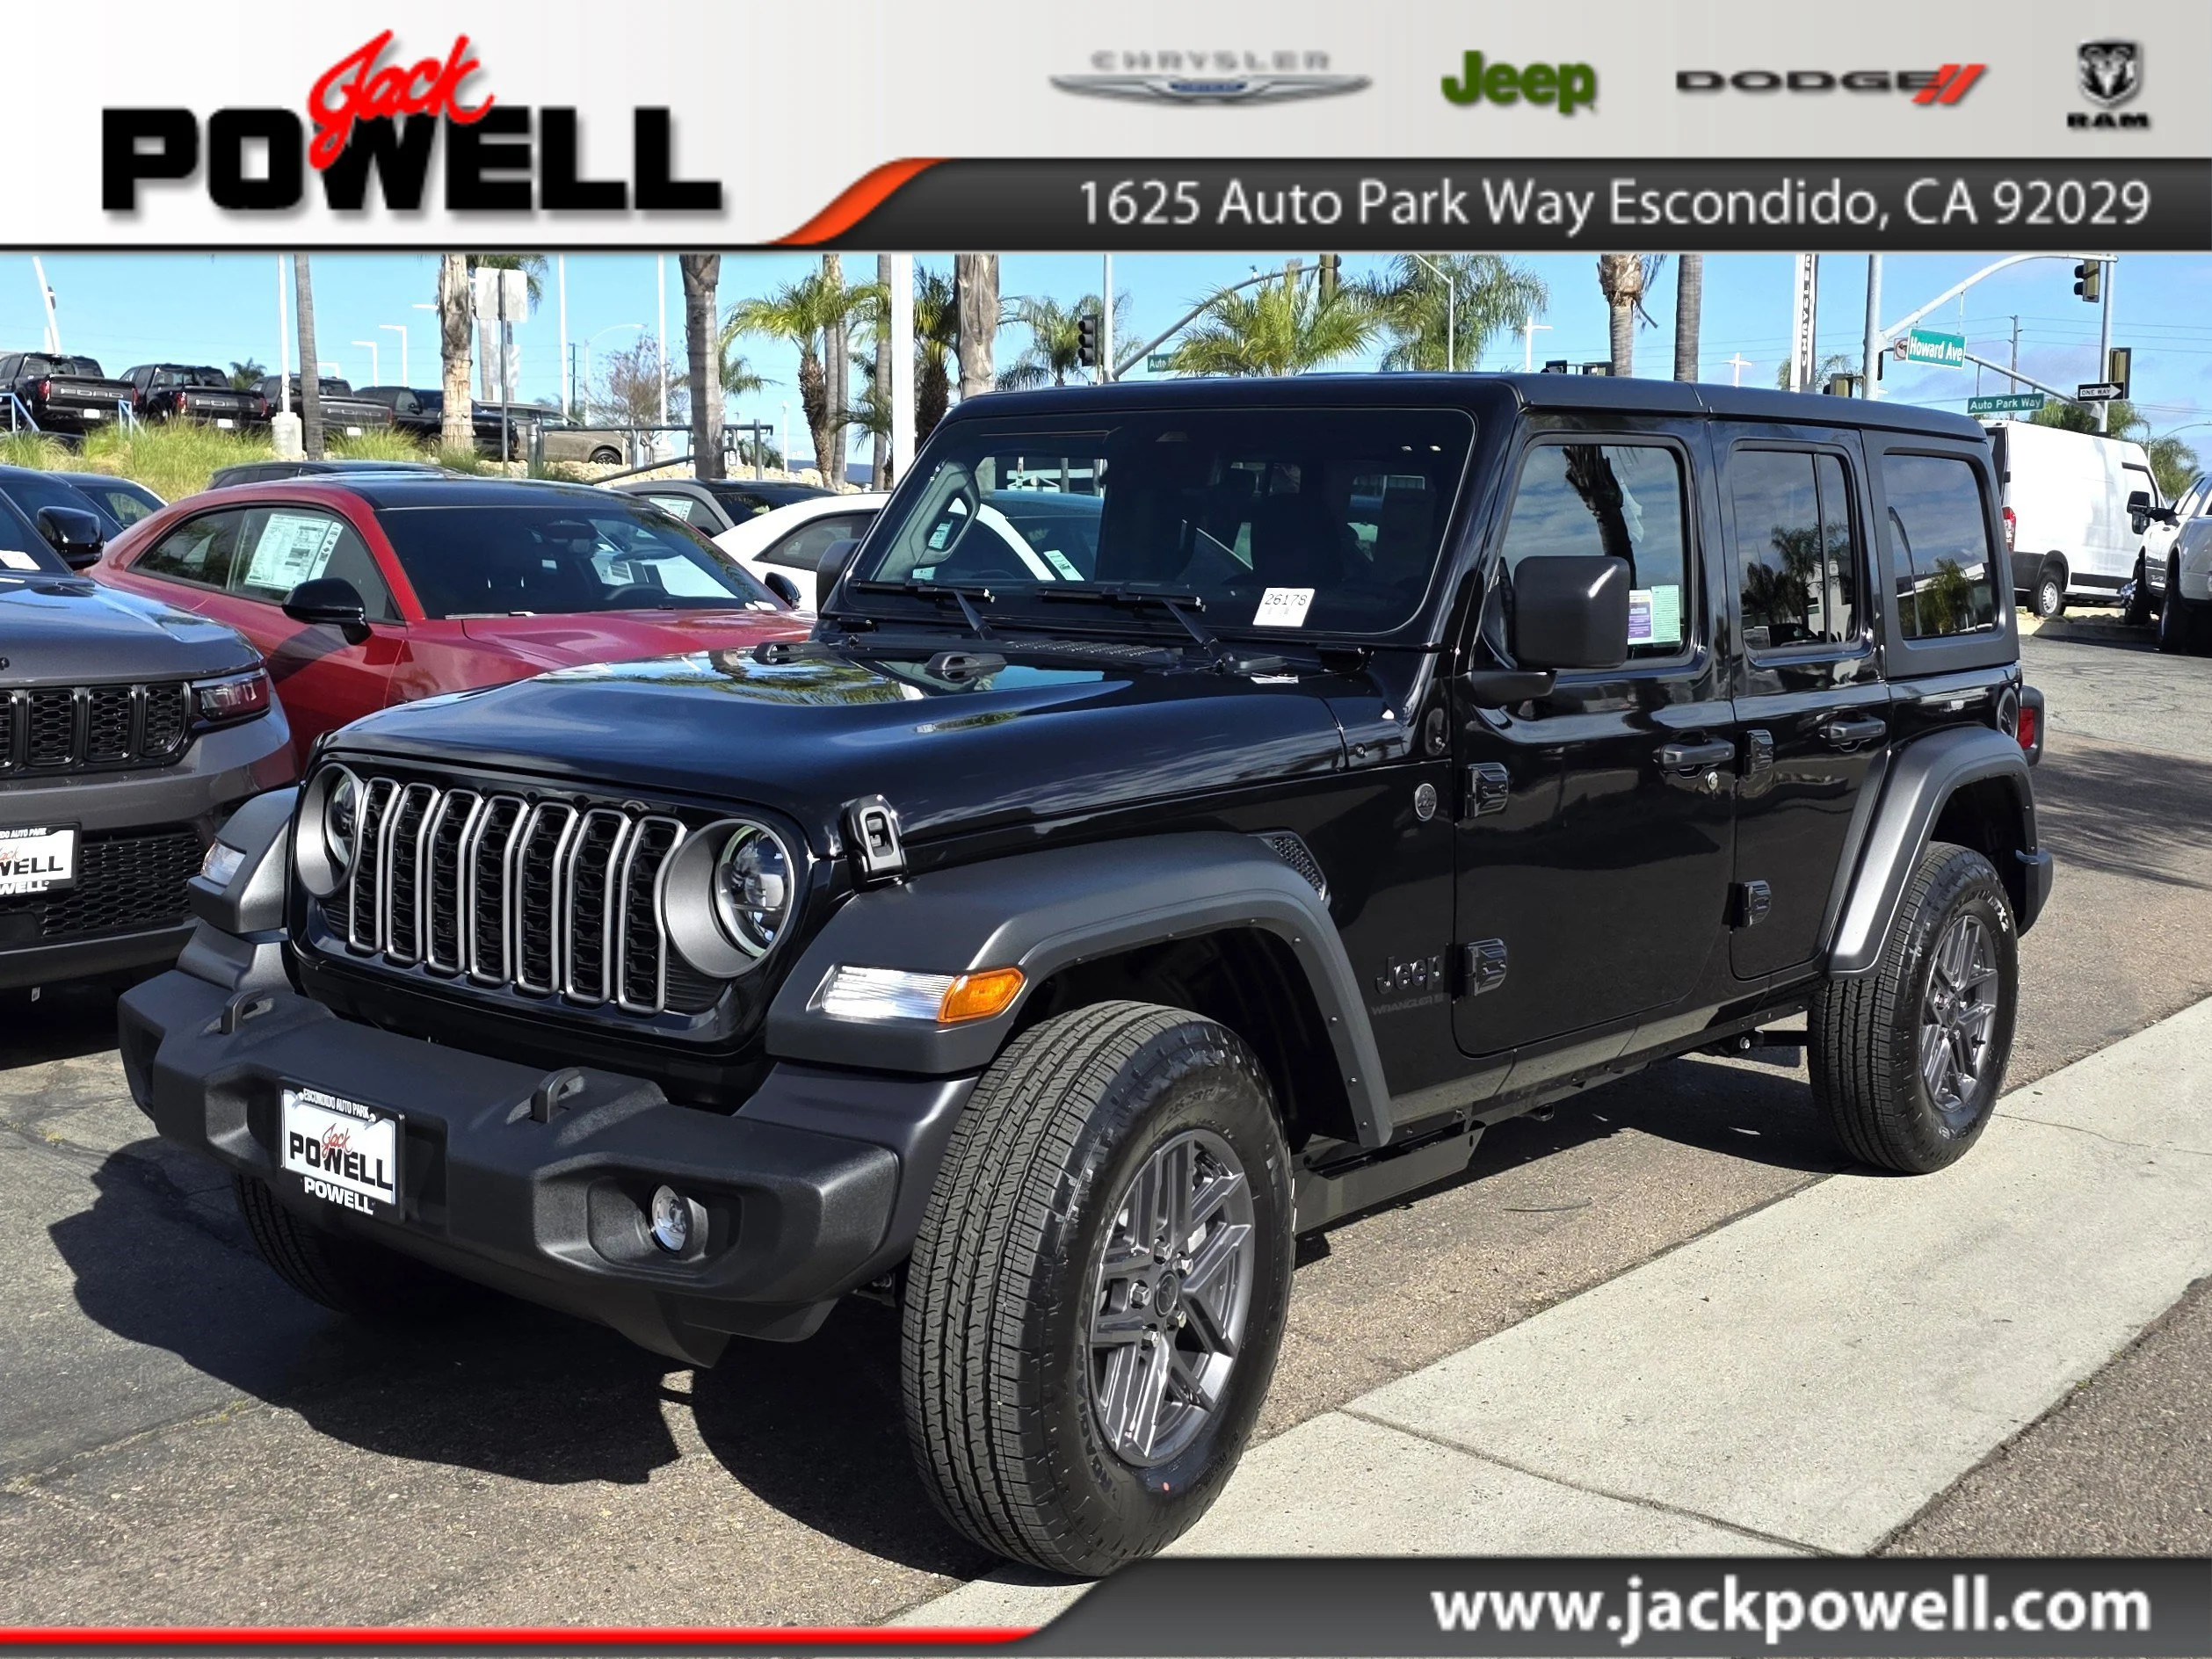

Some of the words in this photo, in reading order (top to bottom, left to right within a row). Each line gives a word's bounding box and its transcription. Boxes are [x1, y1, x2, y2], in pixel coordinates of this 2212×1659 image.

[1909, 336, 1946, 359] Howard
[1945, 341, 1963, 362] Ave
[1149, 358, 1167, 369] Auto
[1969, 401, 1992, 410] Auto
[1996, 399, 2019, 409] Park
[2021, 398, 2042, 409] Way
[11, 830, 29, 838] AUTO
[1374, 954, 1442, 995] Jeep
[336, 1098, 352, 1115] AUTO
[352, 1102, 370, 1120] PARK
[322, 1122, 353, 1159] Jack
[289, 1130, 394, 1192] POWELL
[304, 1176, 374, 1216] POWELL
